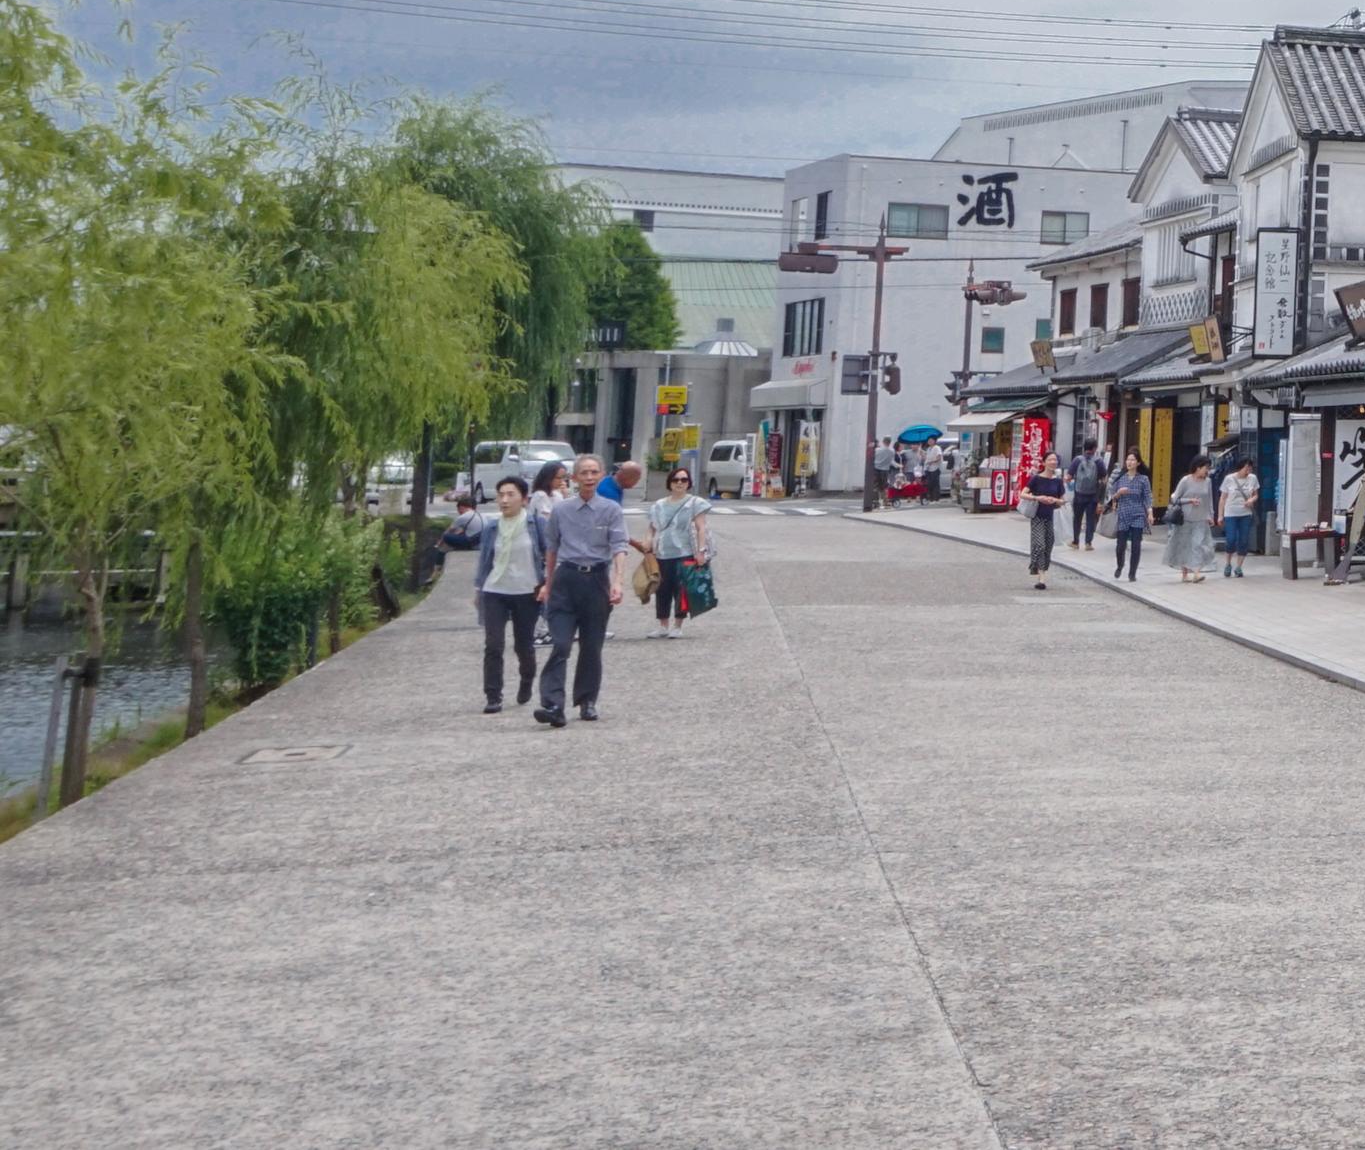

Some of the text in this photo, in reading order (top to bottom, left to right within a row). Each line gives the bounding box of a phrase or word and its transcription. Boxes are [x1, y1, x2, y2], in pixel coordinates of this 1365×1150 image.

[957, 172, 1018, 228] 酒
[1280, 238, 1291, 283] 星野仙一
